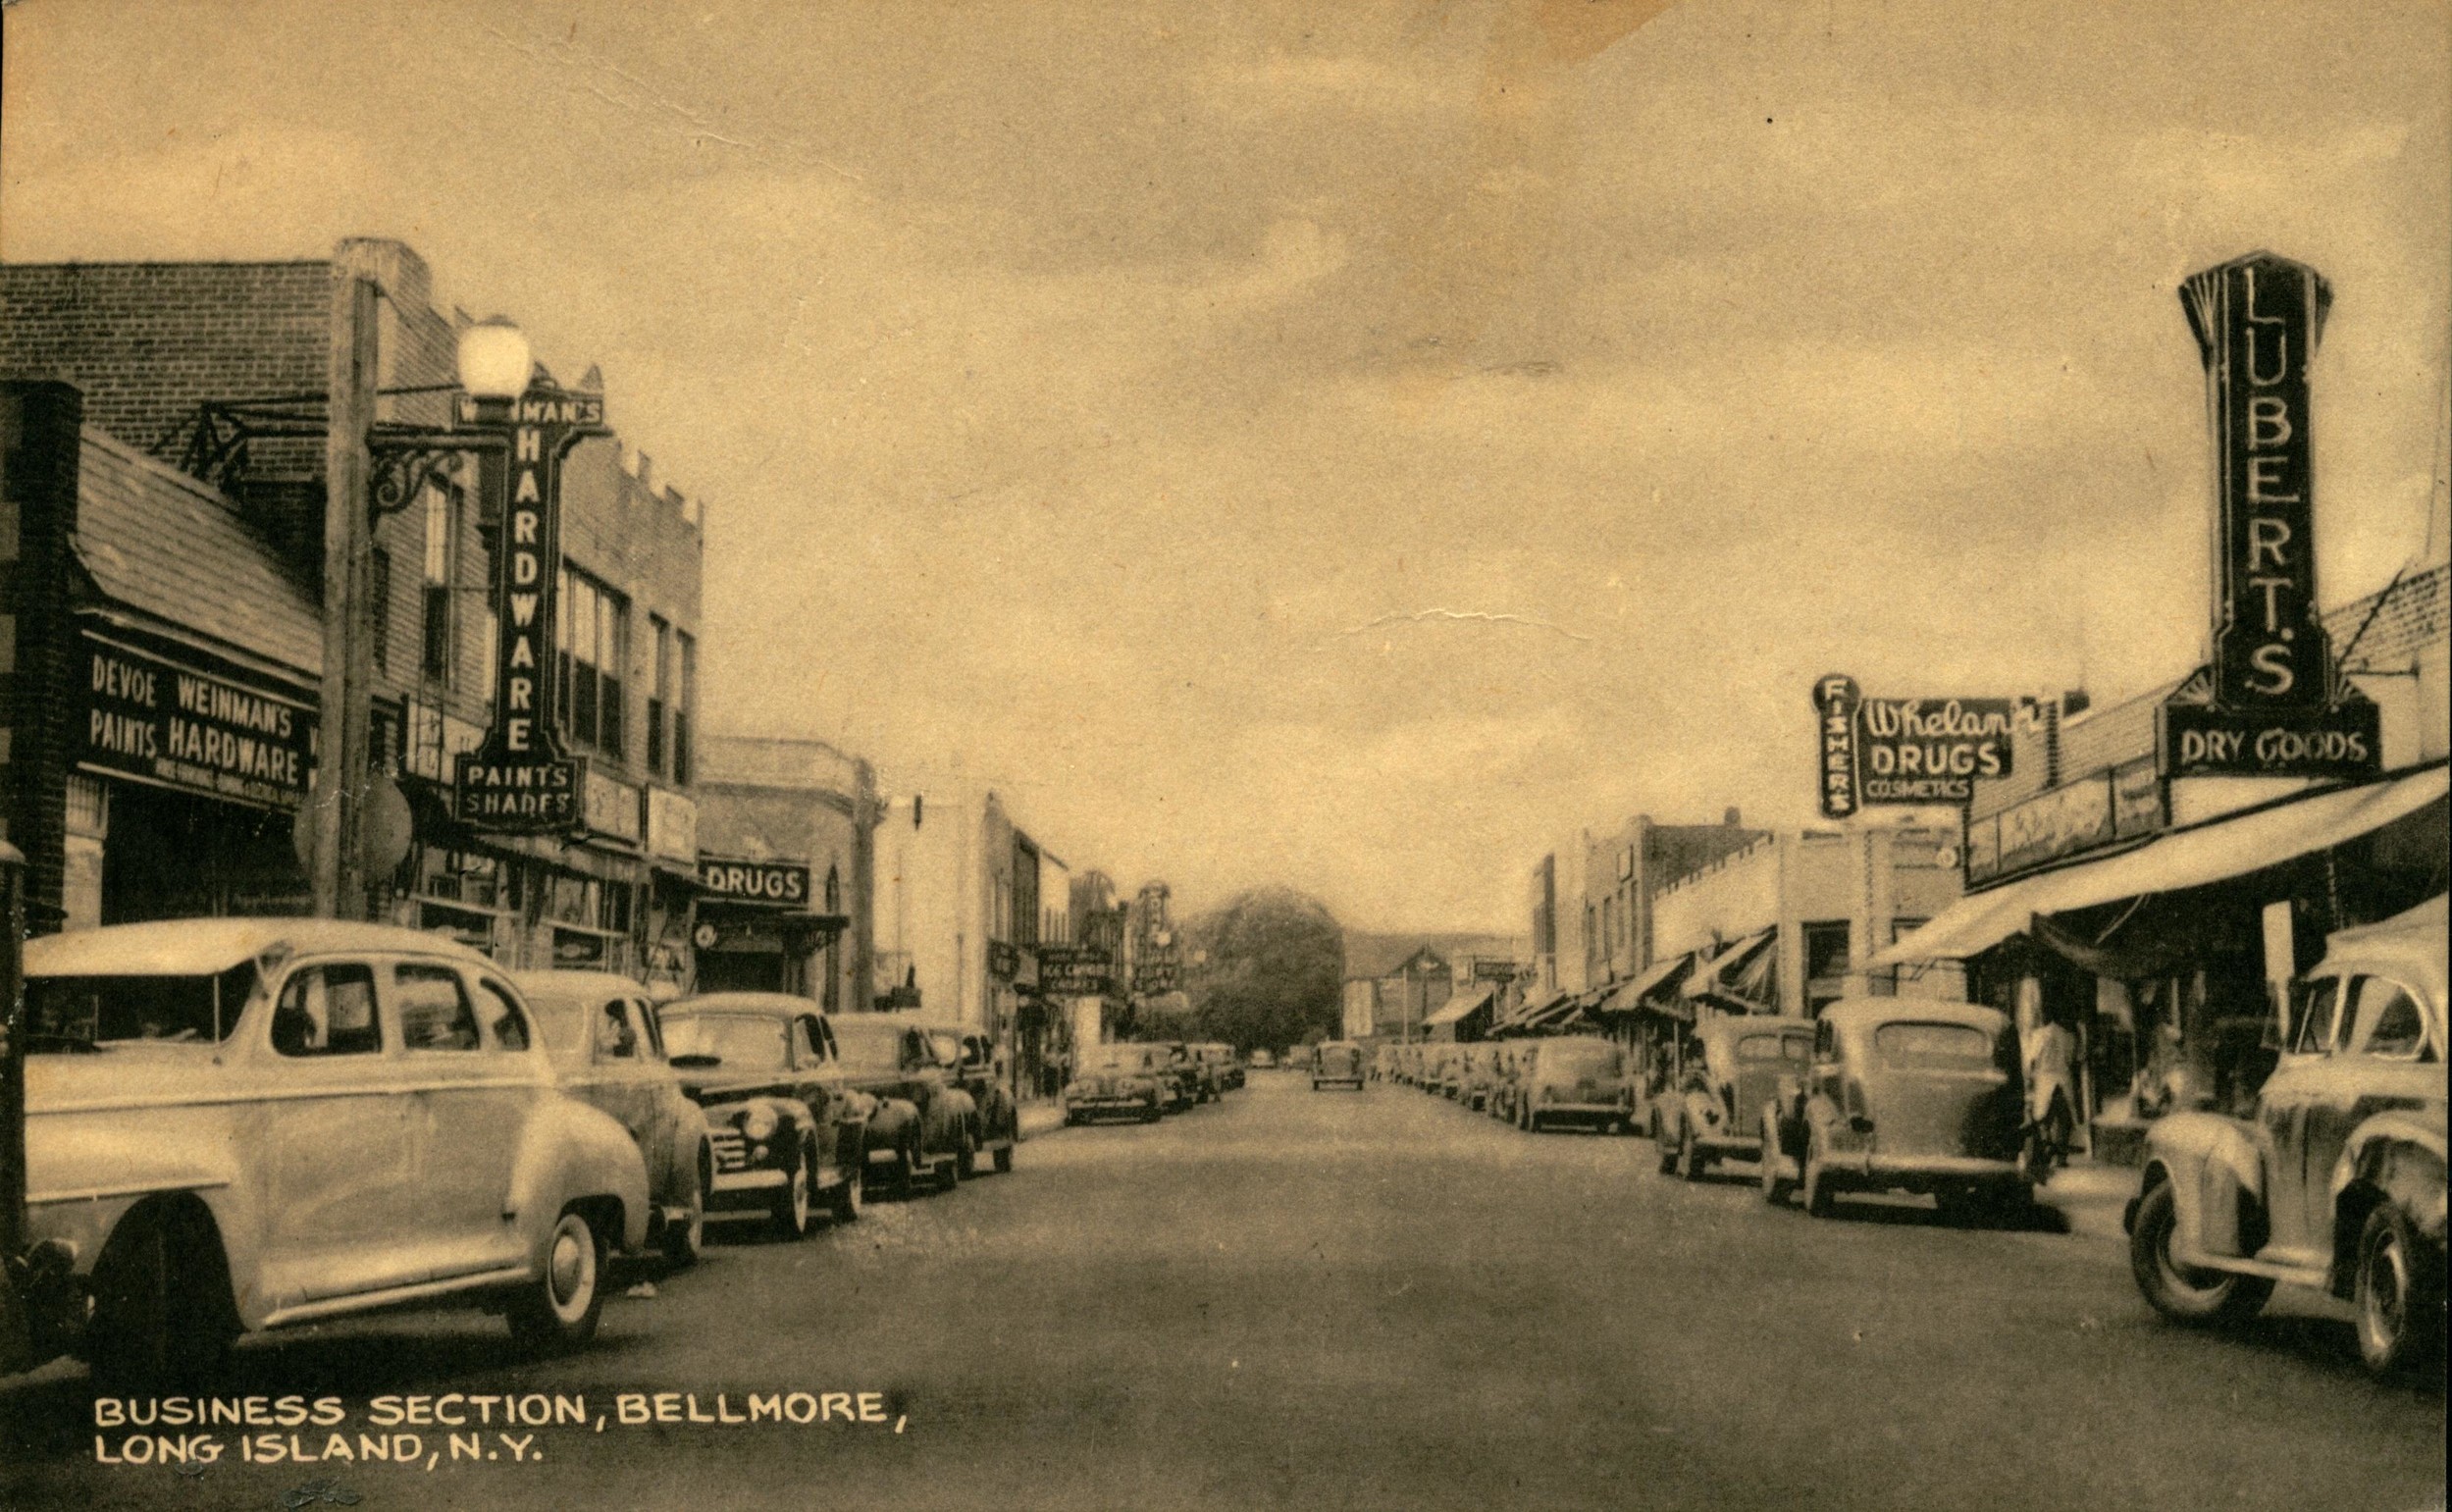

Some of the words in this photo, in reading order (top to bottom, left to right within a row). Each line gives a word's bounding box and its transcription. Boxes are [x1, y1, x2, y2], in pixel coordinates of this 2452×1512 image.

[508, 428, 541, 752] HARDWARE
[92, 654, 157, 707] DEVOE
[178, 674, 291, 737] WEINMAN'S
[90, 709, 157, 759] PAINTS
[169, 716, 298, 785] HARDWARE
[1871, 743, 2001, 775] DRUGS
[2181, 729, 2245, 764] DRY
[2256, 727, 2368, 762] GOODS
[468, 766, 567, 787] PAINTS
[1866, 780, 1969, 799] COSMETICS
[707, 866, 801, 898] DRUGS
